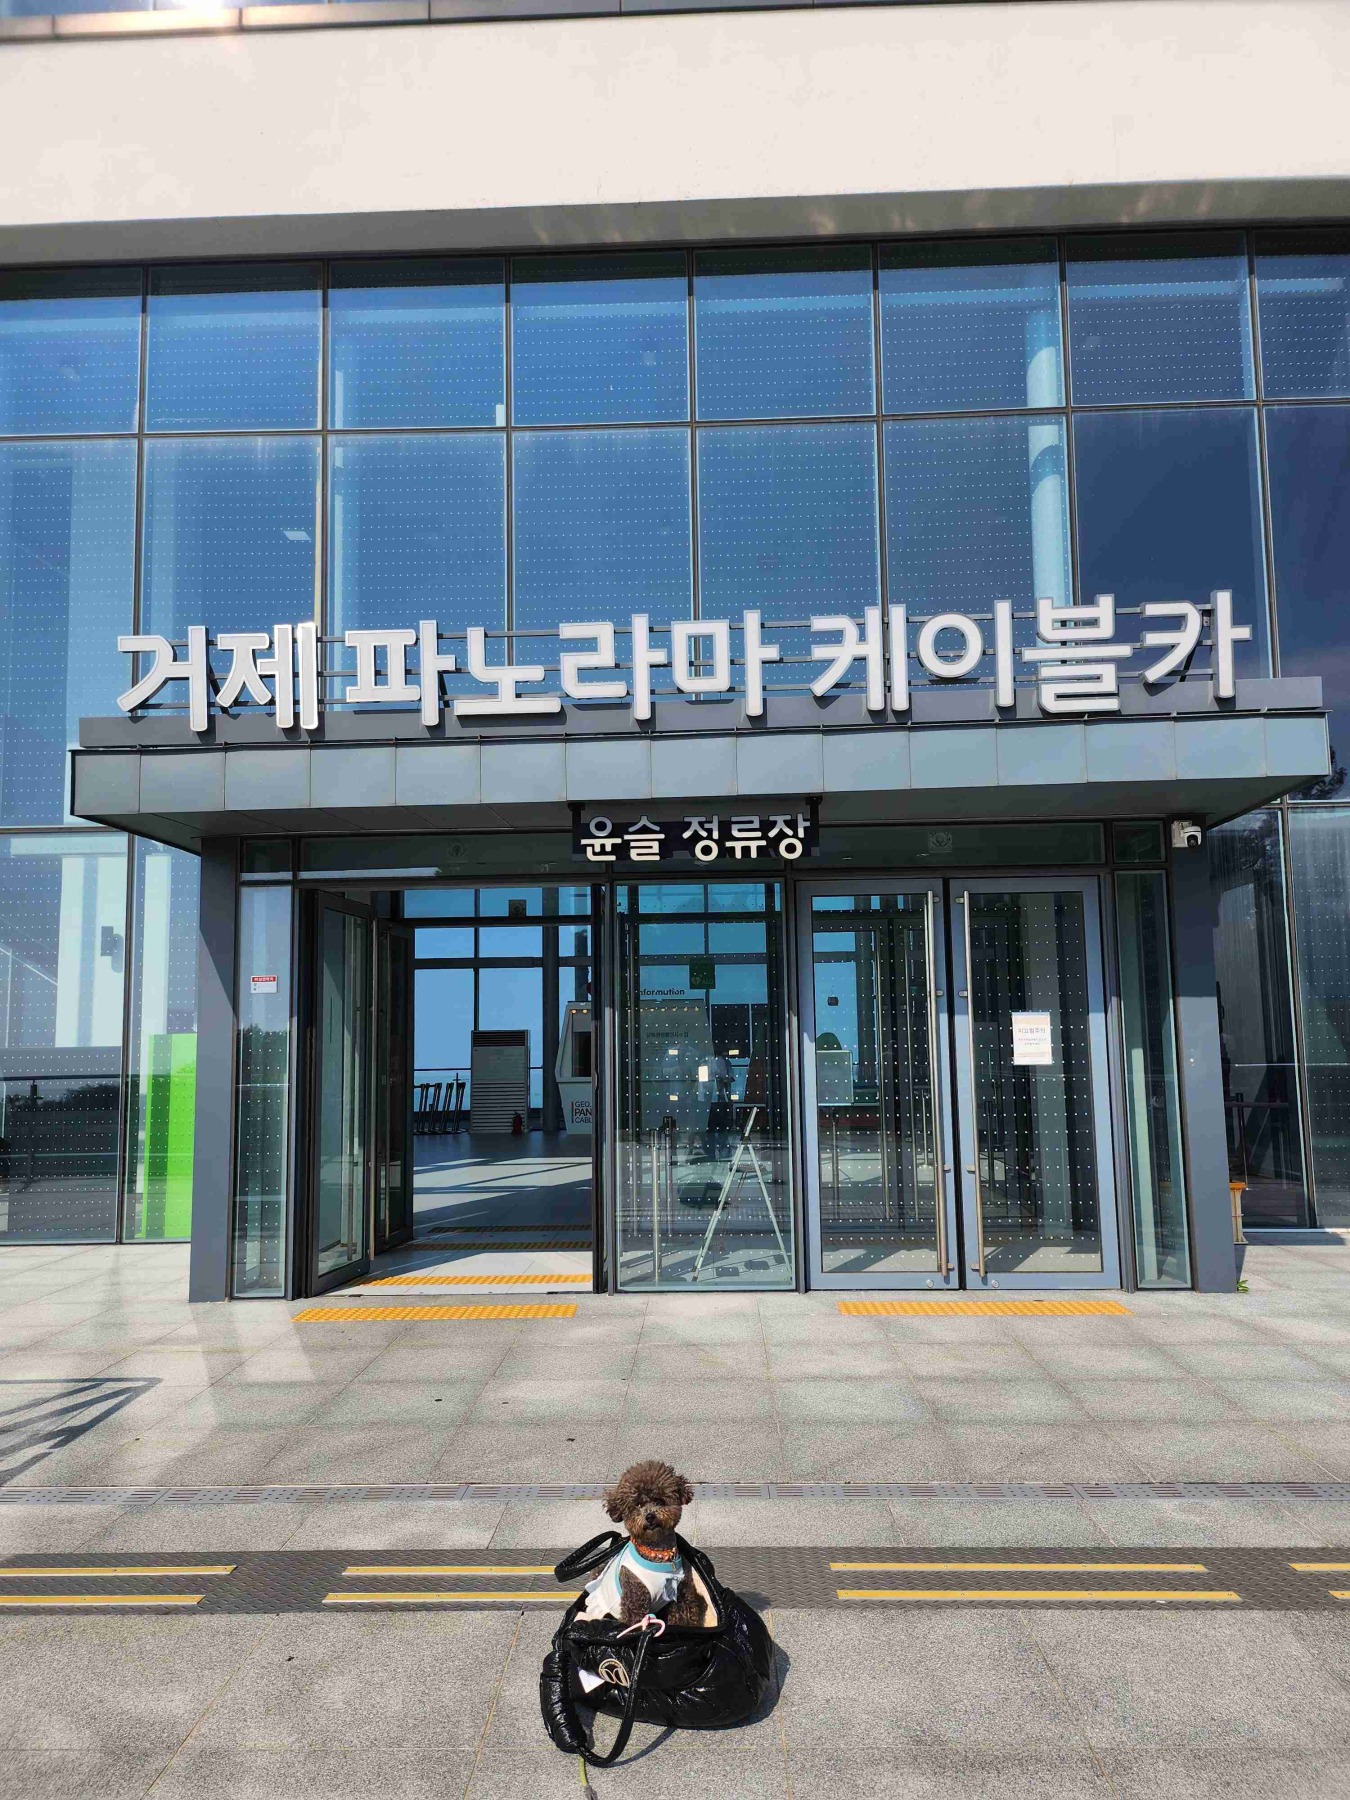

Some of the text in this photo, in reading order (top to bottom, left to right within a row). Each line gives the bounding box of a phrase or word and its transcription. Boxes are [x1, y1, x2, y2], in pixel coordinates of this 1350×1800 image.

[116, 588, 1253, 733] 거제 파노라마 케이블카
[580, 813, 811, 862] 윤슬 정류장
[575, 1100, 592, 1108] GEO
